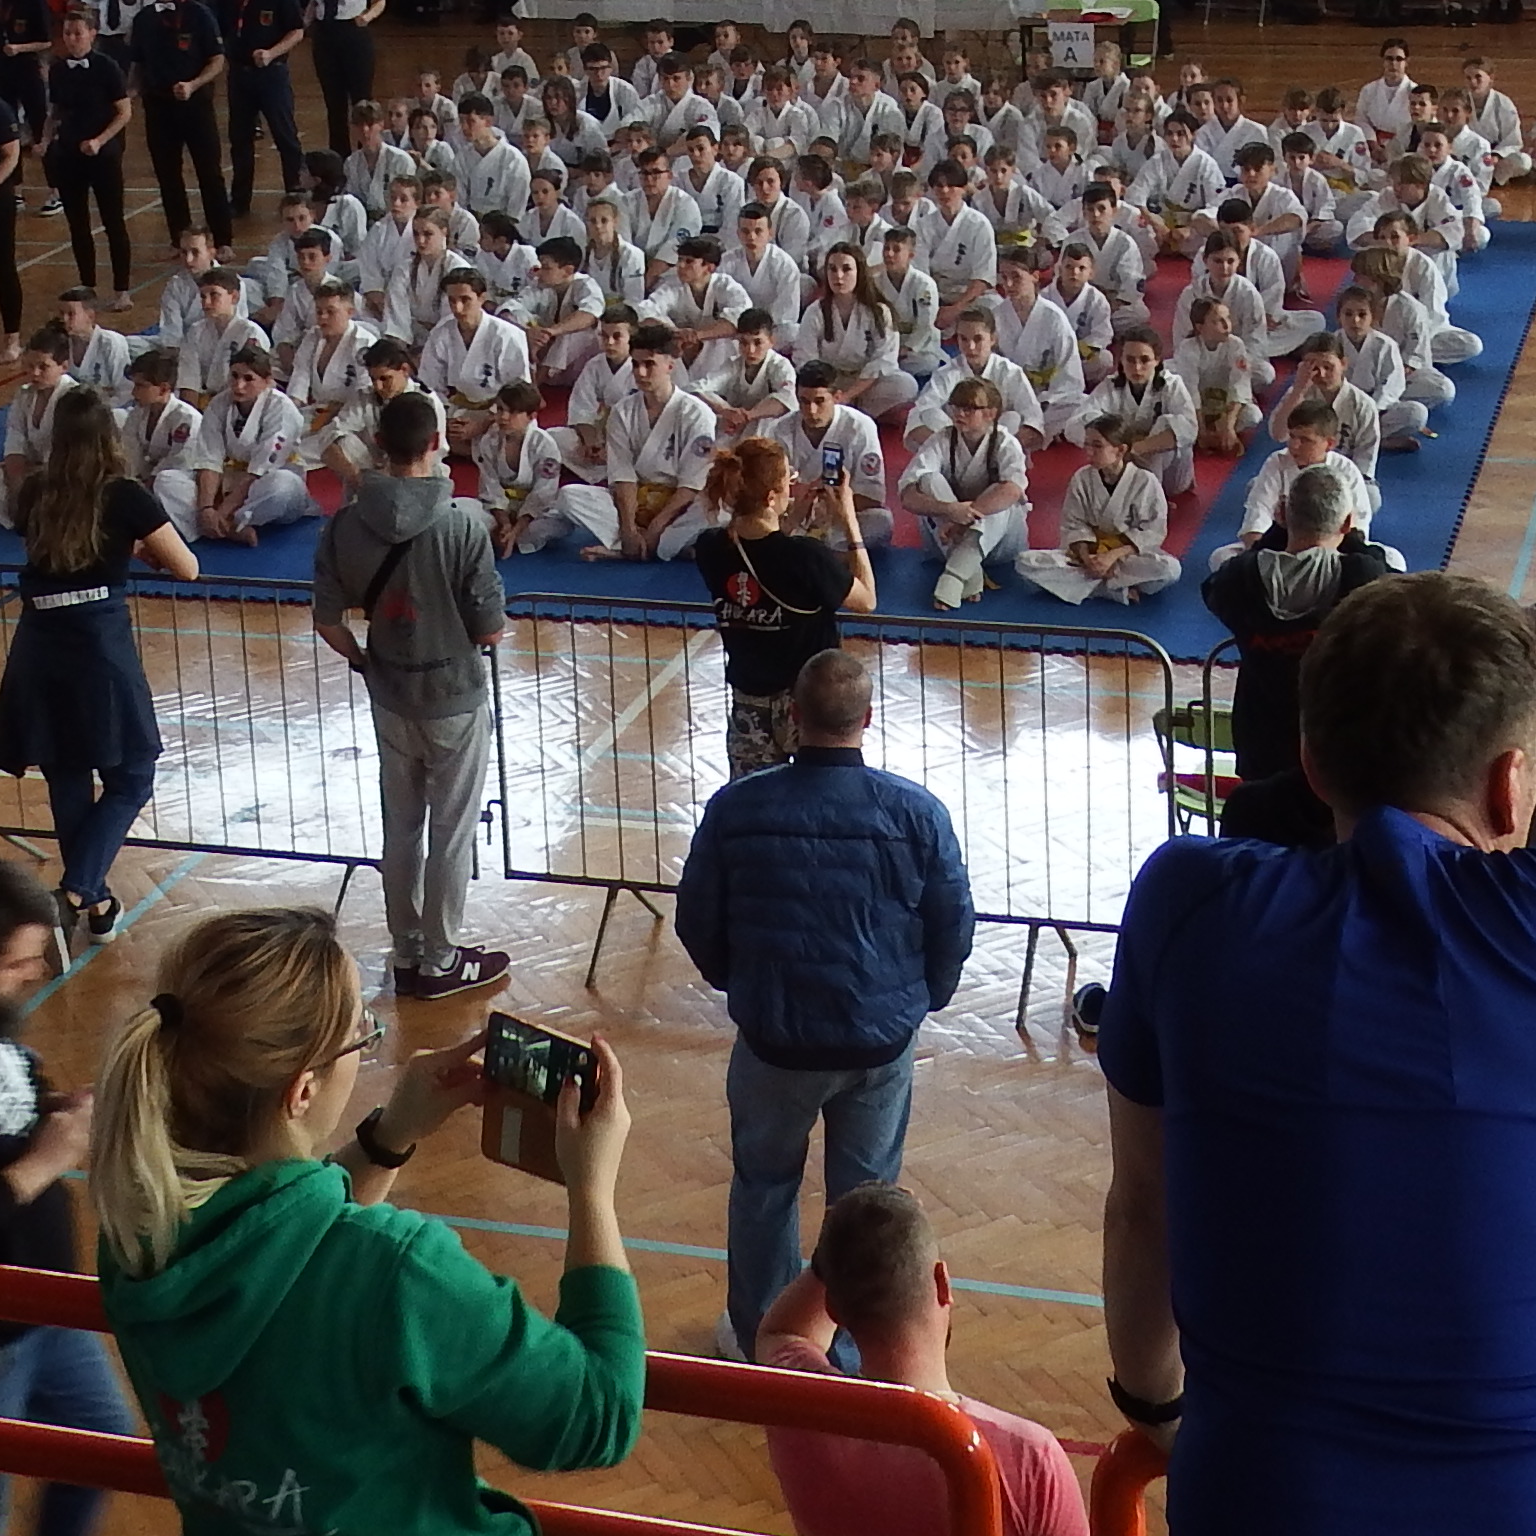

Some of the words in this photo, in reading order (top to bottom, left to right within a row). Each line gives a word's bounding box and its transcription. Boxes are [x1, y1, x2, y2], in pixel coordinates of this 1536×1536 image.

[1052, 30, 1090, 43] MATA
[1063, 46, 1078, 63] A
[460, 961, 481, 981] N
